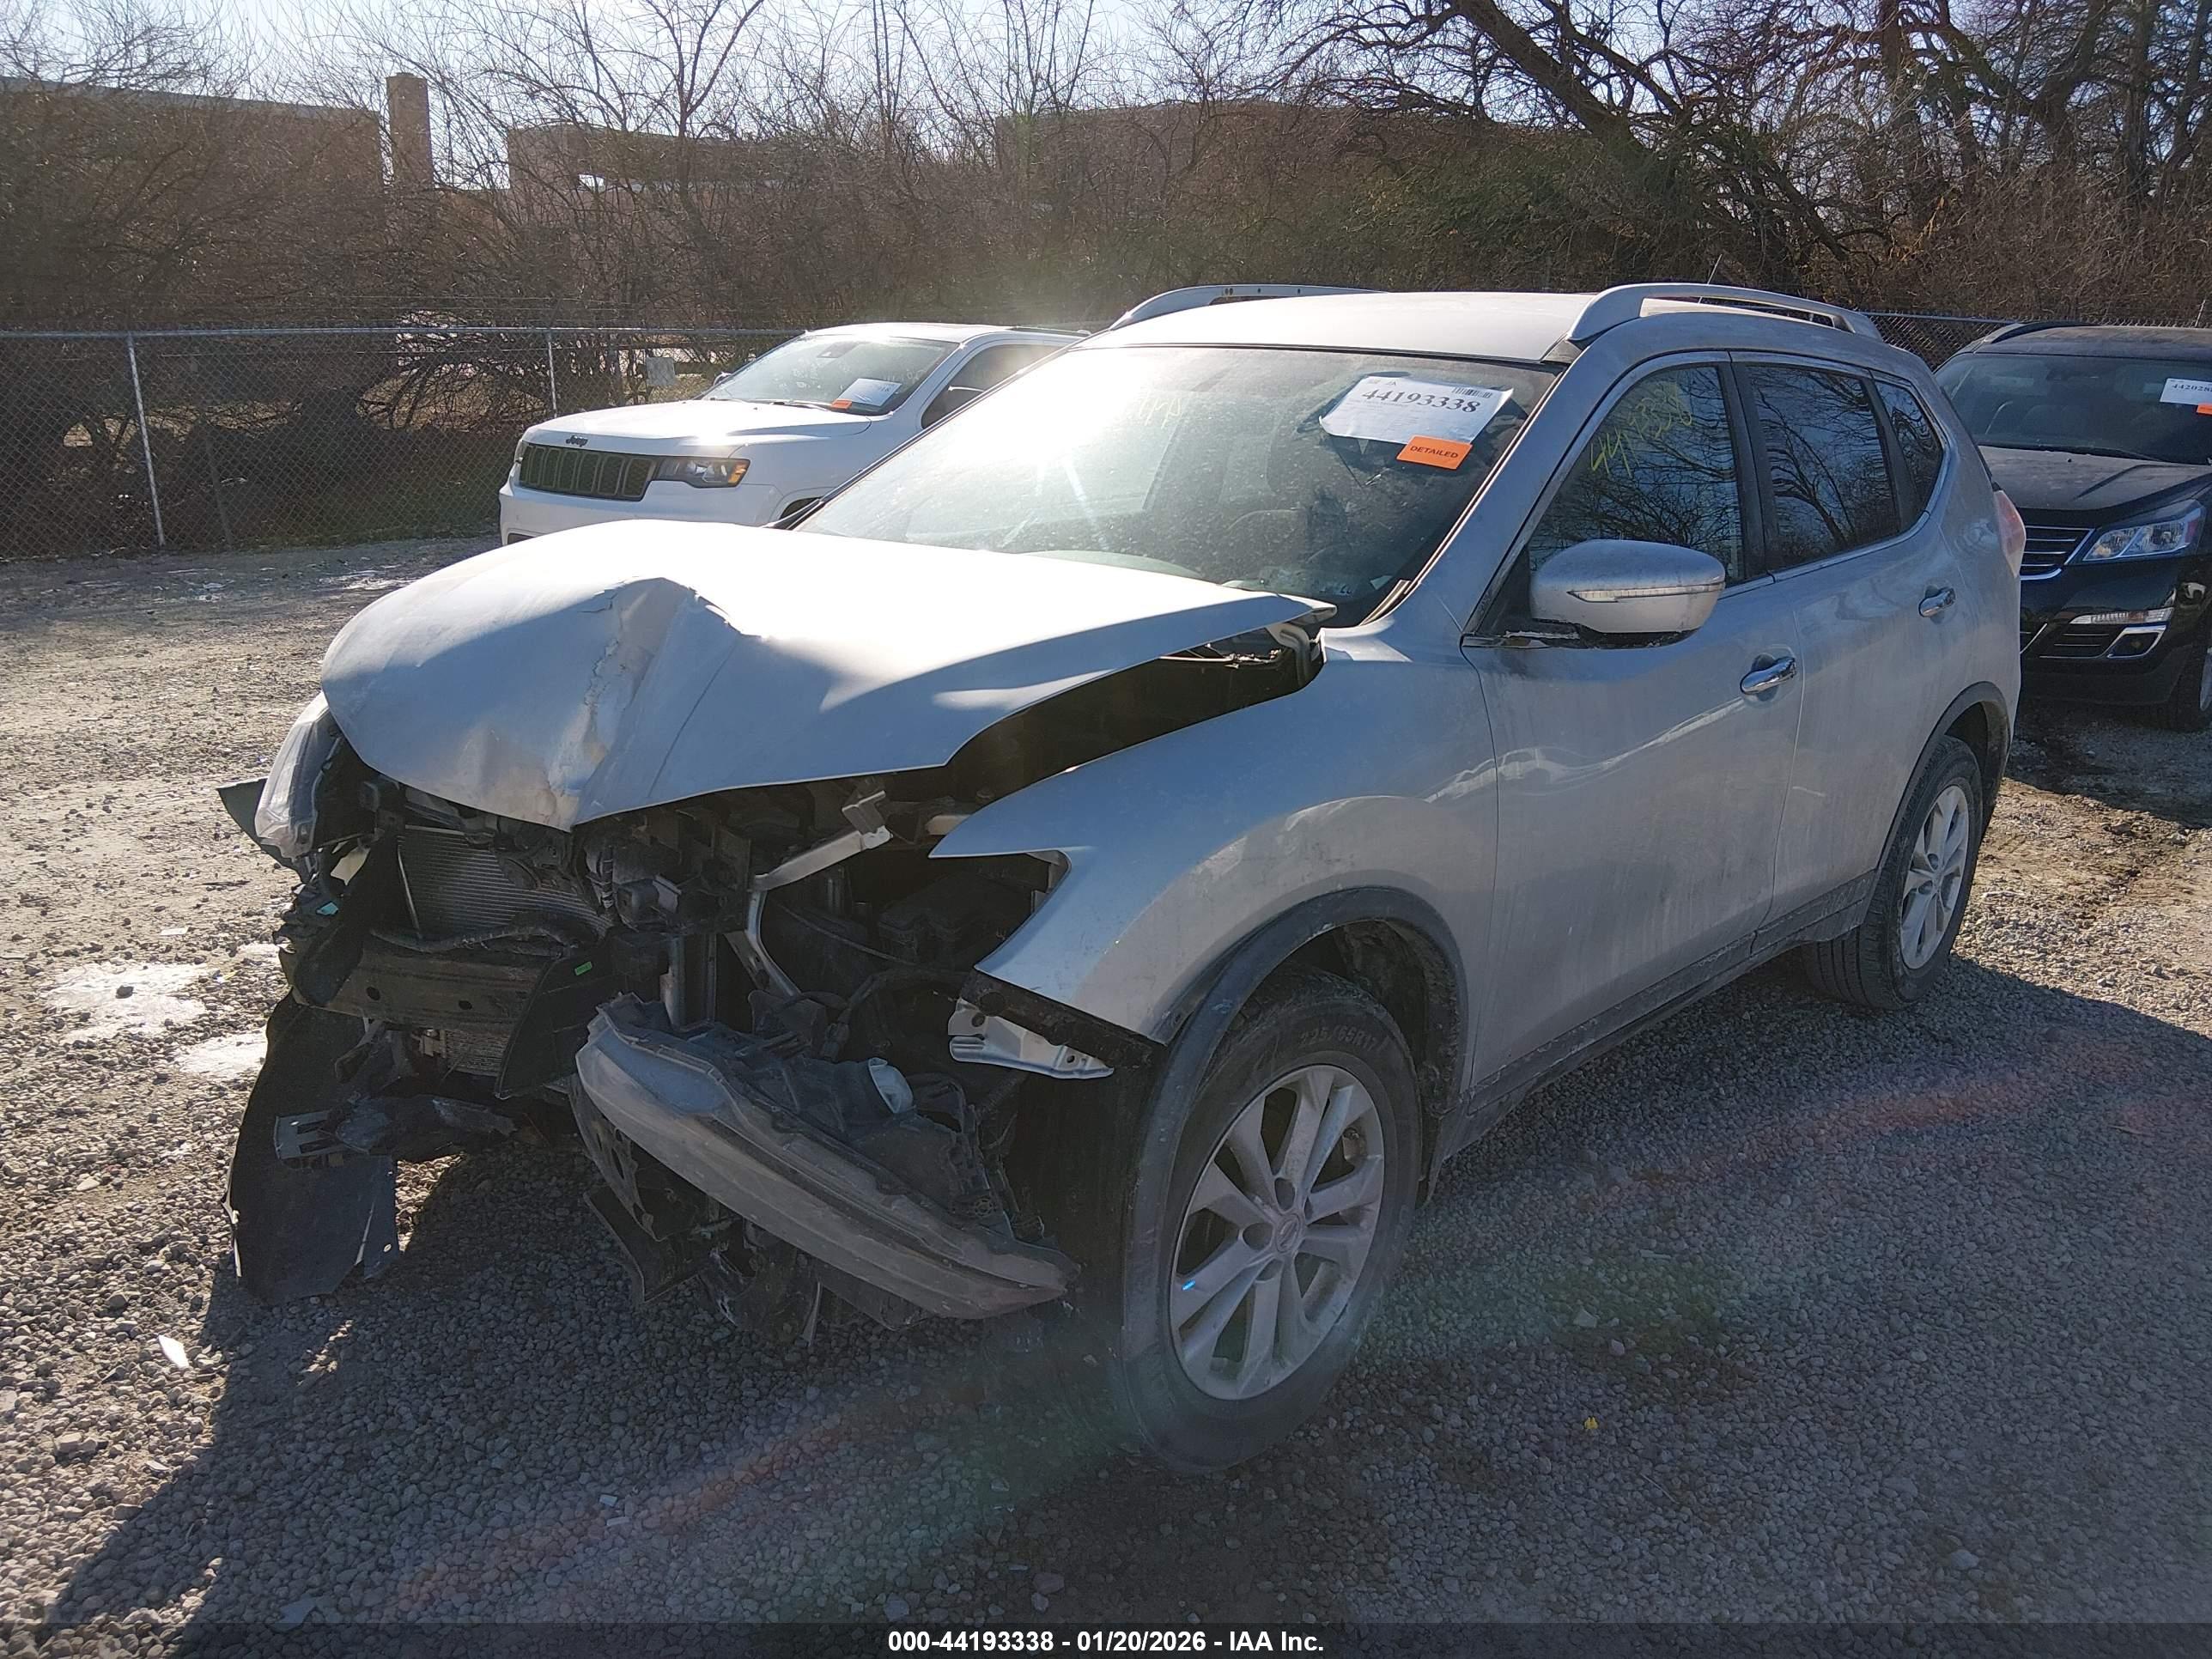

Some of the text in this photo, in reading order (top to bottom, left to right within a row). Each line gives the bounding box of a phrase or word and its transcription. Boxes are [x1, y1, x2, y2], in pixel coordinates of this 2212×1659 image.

[2172, 383, 2212, 392] 442028
[1362, 388, 1481, 413] 44193338
[565, 434, 588, 447] Jeep
[1410, 445, 1458, 459] DETAILED
